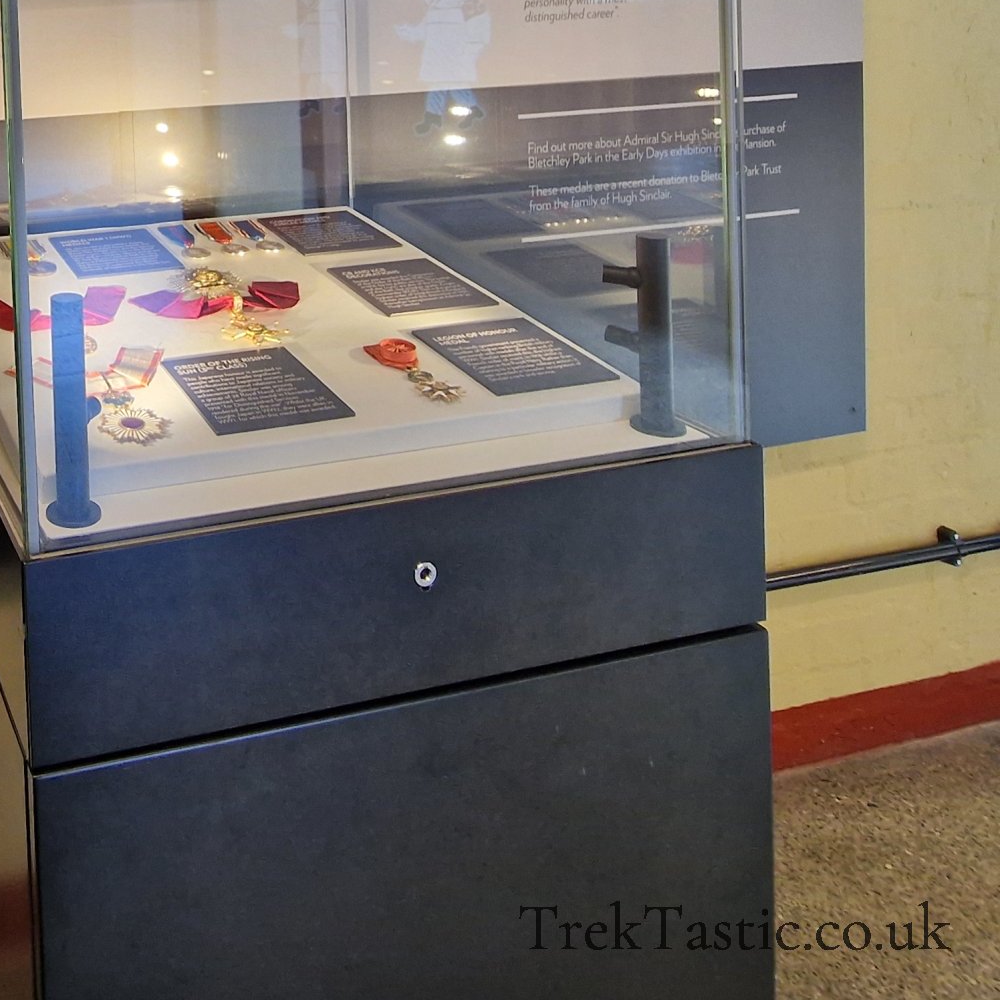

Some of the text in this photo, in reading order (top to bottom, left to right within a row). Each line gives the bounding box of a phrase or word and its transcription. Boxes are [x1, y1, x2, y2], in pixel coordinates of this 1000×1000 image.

[528, 141, 549, 154] Find
[550, 142, 566, 152] out
[568, 142, 593, 151] more
[594, 137, 621, 149] about
[623, 132, 659, 146] Admiral
[661, 131, 673, 144] Sir
[674, 129, 700, 144] Hugh
[744, 124, 775, 135] urchase
[777, 121, 786, 132] of
[528, 154, 570, 170] Bletchley
[573, 152, 592, 165] Park
[595, 153, 603, 162] in
[605, 150, 619, 162] the
[622, 148, 644, 162] Early
[646, 146, 668, 160] Days
[670, 144, 712, 157] exhibition
[529, 184, 558, 197] These
[560, 180, 592, 193] medals
[594, 183, 609, 192] are
[618, 178, 647, 188] recent
[649, 175, 688, 185] donation
[690, 174, 699, 183] to
[762, 163, 782, 174] Trust
[529, 189, 672, 213] from the family of Hugh Sinclair.
